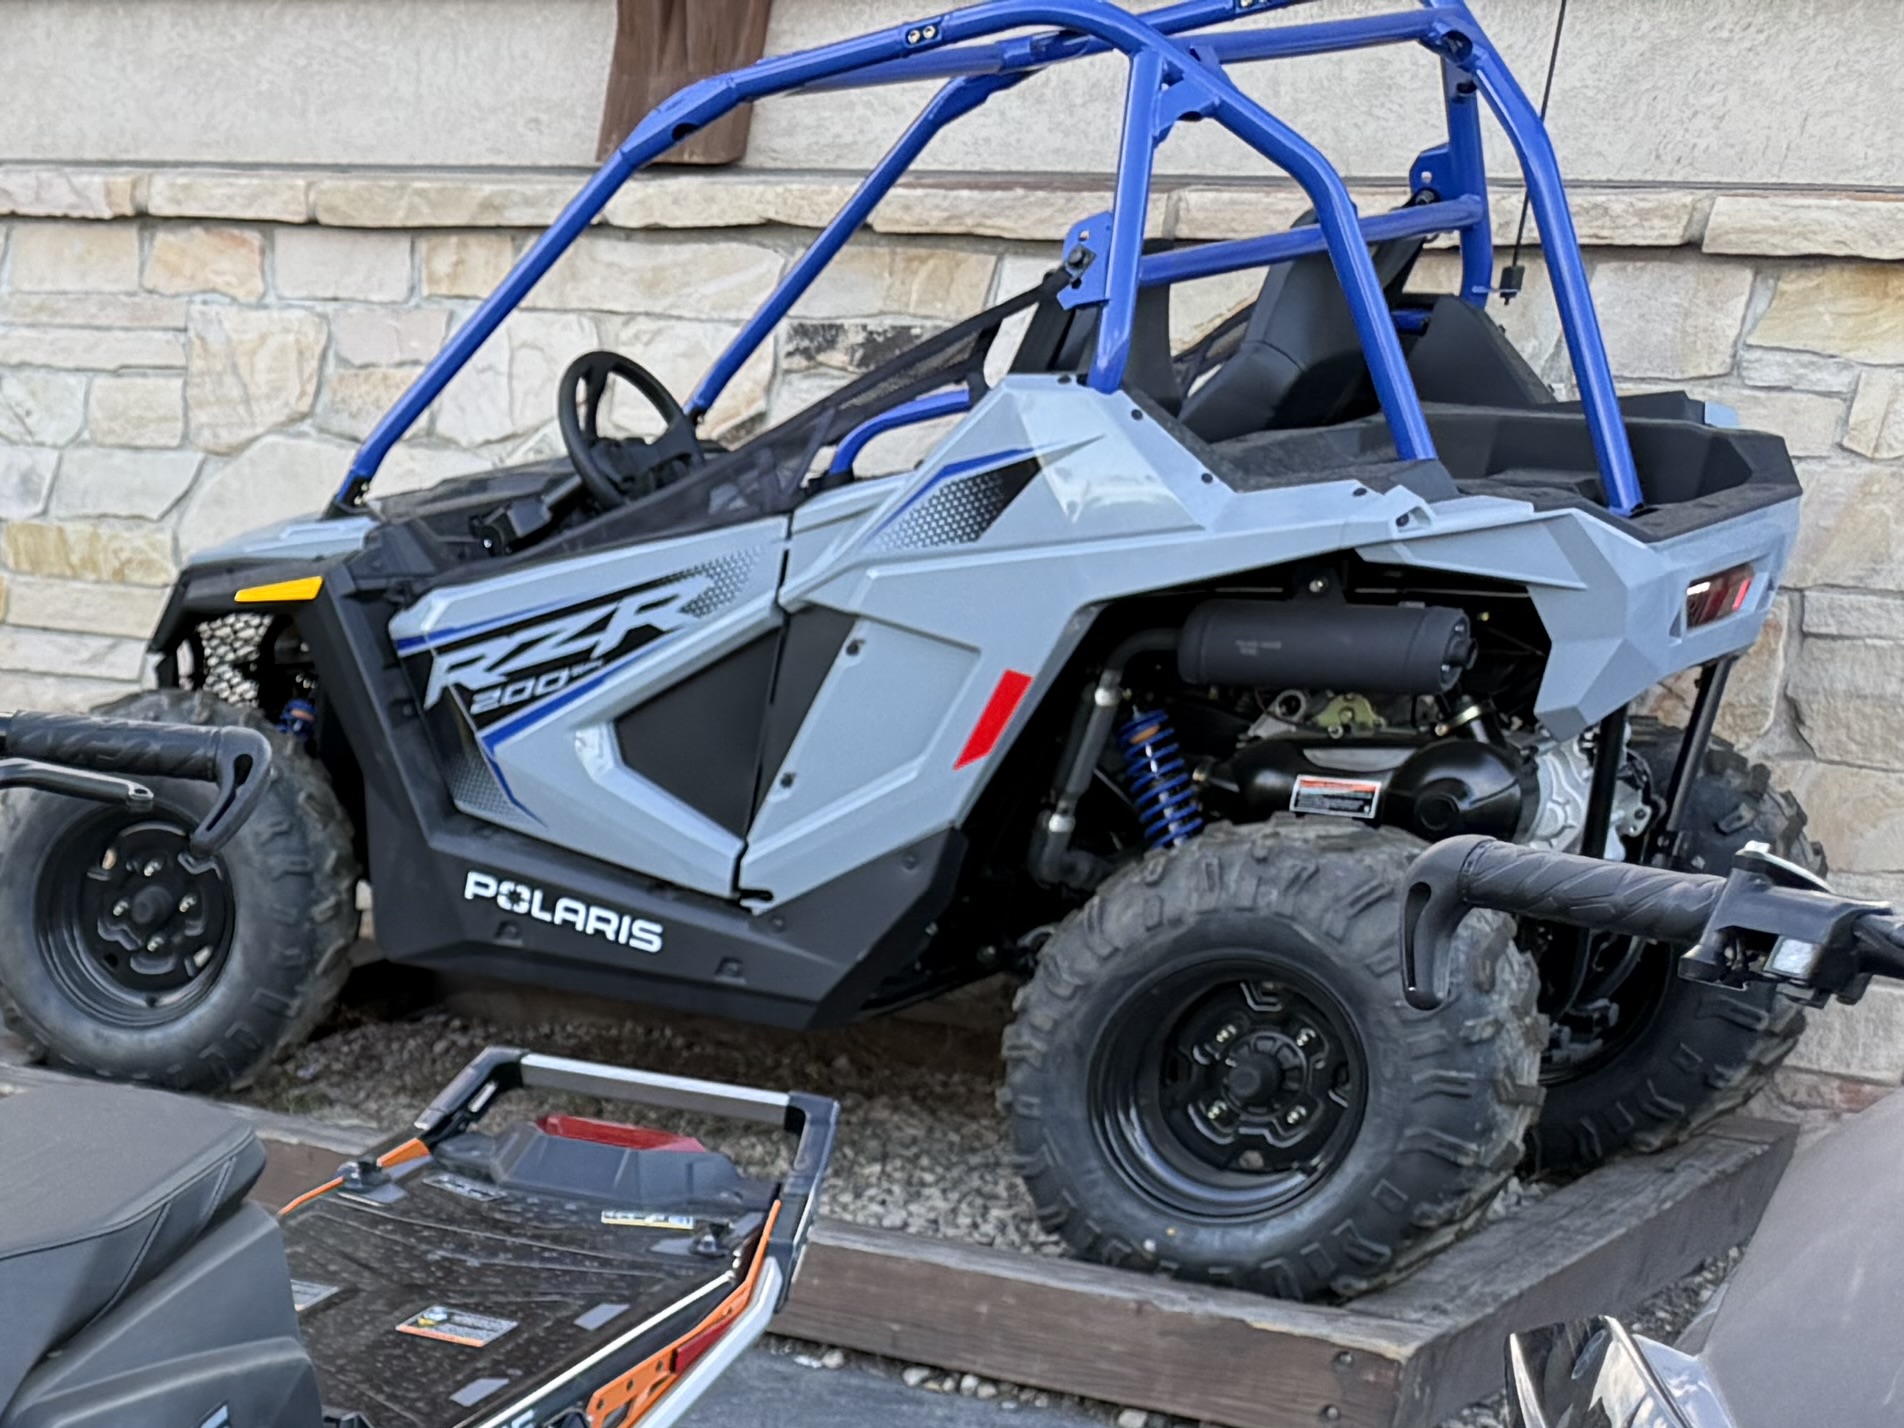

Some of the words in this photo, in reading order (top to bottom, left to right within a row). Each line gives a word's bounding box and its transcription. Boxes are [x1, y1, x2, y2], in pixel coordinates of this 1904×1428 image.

[424, 576, 716, 711] RZR
[470, 667, 570, 714] 200
[463, 870, 665, 954] POLARIS
